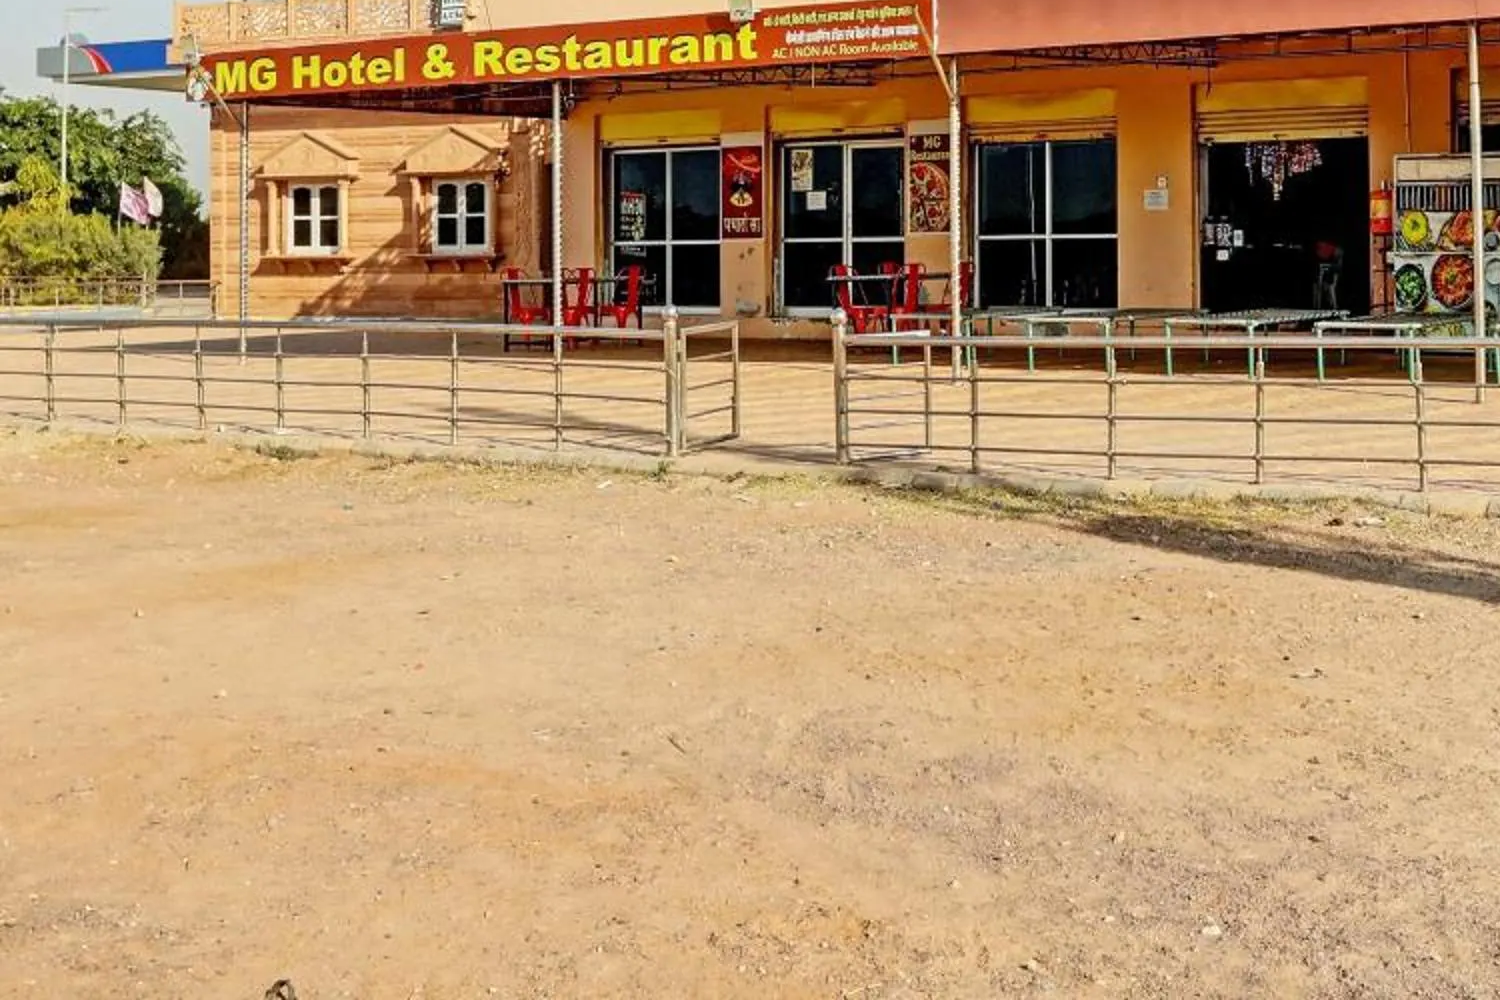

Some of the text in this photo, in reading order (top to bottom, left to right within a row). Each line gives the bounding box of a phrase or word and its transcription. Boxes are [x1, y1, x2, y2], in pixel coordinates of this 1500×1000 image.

[214, 58, 277, 94] MG
[292, 48, 405, 89] Hotel
[421, 43, 456, 80] &
[473, 22, 758, 77] Restaurant
[823, 45, 837, 56] AC
[839, 44, 869, 55] Room
